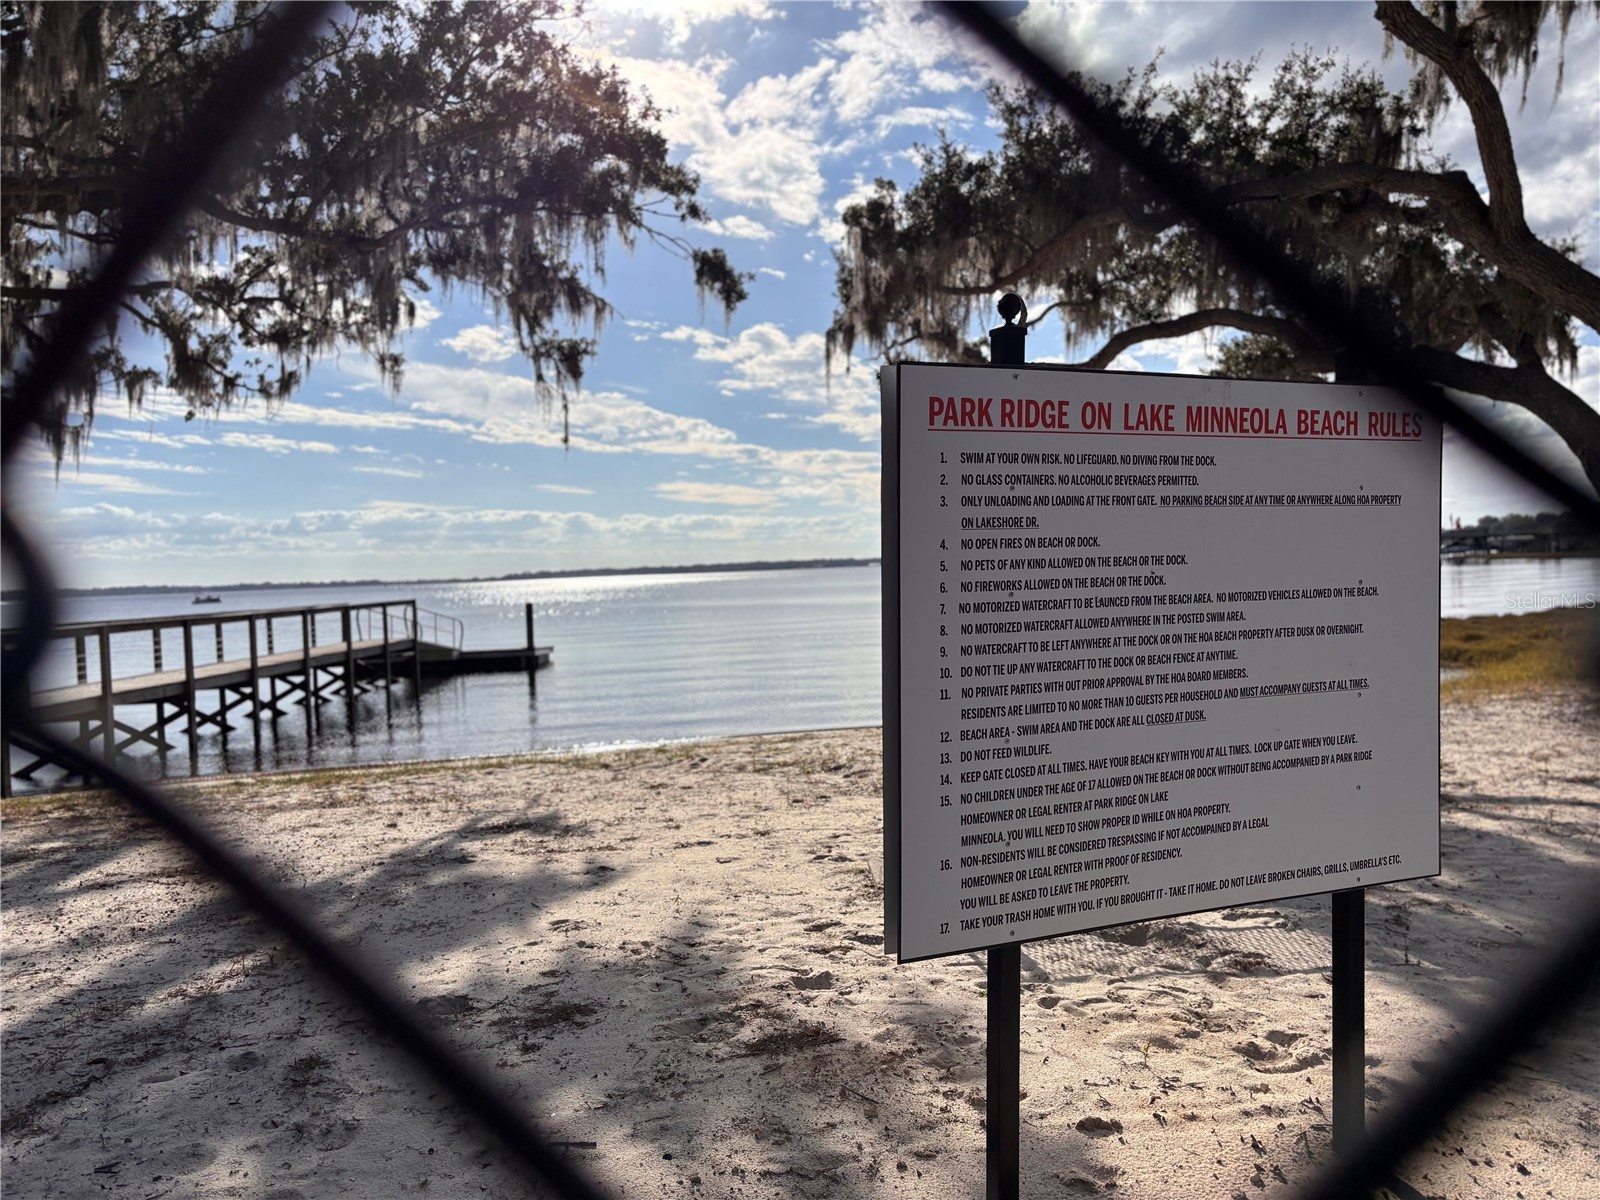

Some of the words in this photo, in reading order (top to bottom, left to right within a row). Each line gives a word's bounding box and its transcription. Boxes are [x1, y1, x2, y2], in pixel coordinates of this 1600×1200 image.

[929, 397, 993, 427] PARK
[1001, 399, 1070, 429] RIDGE
[1081, 402, 1112, 430] ON
[1124, 403, 1175, 431] LAKE
[1186, 406, 1288, 434] MINNEOLA
[1297, 409, 1358, 436] BEACH
[1368, 412, 1422, 437] RULES
[941, 452, 947, 463] 1.
[960, 453, 984, 464] SWIM
[985, 453, 996, 464] AT
[997, 453, 1019, 464] YOUR
[1021, 453, 1040, 464] OWN
[1041, 454, 1062, 464] RISK.
[1064, 454, 1075, 465] NO
[1077, 454, 1119, 465] LIFEGUARD.
[1120, 455, 1131, 465] NO
[1132, 455, 1157, 465] DIVING
[1159, 455, 1179, 466] FROM
[1181, 456, 1194, 466] THE
[1196, 456, 1216, 466] DOCK.
[940, 474, 948, 485] 2.
[961, 474, 974, 485] NO
[975, 474, 1003, 485] GLASS
[1004, 474, 1057, 485] CONTAINERS.
[1058, 475, 1070, 485] NO
[1071, 475, 1113, 485] ALCOHOLIC
[1114, 475, 1156, 485] BEVERAGES
[1158, 475, 1199, 485] PERMITTED.
[940, 496, 948, 507] 3.
[961, 496, 983, 507] ONLY
[984, 495, 1032, 506] UNLOADING
[1033, 495, 1050, 506] AND
[1051, 495, 1085, 506] LOADING
[1086, 495, 1095, 506] AT
[1096, 495, 1110, 506] THE
[1112, 495, 1136, 506] FRONT
[1137, 495, 1157, 506] GATE.
[1160, 495, 1171, 505] NO
[1172, 495, 1203, 505] PARKING
[1204, 495, 1227, 505] BEACH
[1229, 495, 1244, 505] SIDE
[1245, 495, 1253, 505] AT
[1254, 495, 1268, 505] ANY
[1269, 495, 1285, 505] TIME
[1286, 495, 1296, 505] OR
[1297, 495, 1333, 505] ANYWHERE
[1334, 495, 1356, 504] ALONG
[1357, 495, 1370, 504] HOA
[1371, 495, 1402, 504] PROPERTY
[962, 517, 974, 528] ON
[976, 517, 1024, 528] LAKESHORE
[1026, 517, 1039, 527] DR.
[940, 539, 948, 550] 4.
[961, 539, 974, 550] NO
[975, 538, 998, 550] OPEN
[1000, 538, 1022, 549] FIRES
[1024, 538, 1036, 549] ON
[1038, 537, 1063, 548] BEACH
[1065, 537, 1076, 548] OR
[1077, 537, 1100, 547] DOCK.
[940, 561, 948, 572] 5.
[961, 560, 973, 571] NO
[975, 559, 996, 571] PETS
[997, 559, 1009, 570] OF
[1009, 559, 1026, 570] ANY
[1027, 558, 1046, 569] KIND
[1047, 557, 1084, 569] ALLOWED
[1085, 557, 1096, 568] ON
[1097, 557, 1111, 567] THE
[1113, 556, 1138, 567] BEACH
[1139, 556, 1149, 566] OR
[1151, 555, 1164, 566] THE
[1166, 555, 1188, 565] DOCK.
[940, 582, 948, 593] 6.
[961, 581, 973, 593] NO
[974, 580, 1023, 592] FIREWORKS
[1024, 578, 1060, 590] ALLOWED
[1062, 578, 1073, 589] ON
[1074, 577, 1089, 589] THE
[1090, 577, 1115, 588] BEACH
[1116, 576, 1127, 587] OR
[1128, 576, 1142, 587] THE
[1144, 575, 1166, 586] DOCK.
[940, 625, 948, 636] 8.
[961, 624, 973, 635] NO
[975, 621, 1022, 635] MOTORIZED
[1023, 619, 1074, 632] WATERCRAFT
[1074, 617, 1109, 630] ALLOWED
[1110, 615, 1151, 628] ANYWHERE
[1153, 615, 1161, 625] IN
[1162, 614, 1176, 625] THE
[1177, 613, 1205, 624] POSTED
[1206, 612, 1225, 623] SWIM
[1226, 611, 1246, 622] AREA.
[941, 752, 952, 764] 13.
[960, 751, 972, 762] DO
[974, 749, 991, 761] NOT
[992, 747, 1012, 760] FEED
[1013, 743, 1052, 758] WILDLIFE.
[961, 809, 1014, 827] HOMEOWNER
[1015, 807, 1027, 820] OR
[1028, 804, 1052, 818] LEGAL
[1054, 801, 1083, 815] RENTER
[1084, 800, 1093, 811] AT
[1094, 797, 1113, 810] PARK
[1115, 794, 1137, 807] RIDGE
[1138, 793, 1149, 805] ON
[1151, 791, 1168, 803] LAKE
[961, 831, 1006, 847] MINNEOLA.
[1007, 828, 1023, 841] YOU
[1024, 826, 1044, 839] WILL
[1045, 823, 1065, 836] NEED
[1066, 822, 1076, 834] TO
[1078, 819, 1100, 832] SHOW
[1102, 815, 1131, 829] PROPER
[1132, 814, 1140, 825] ID
[1141, 811, 1164, 824] WHILE
[1165, 810, 1176, 821] ON
[1177, 808, 1192, 819] HOA
[1193, 803, 1230, 817] PROPERTY.
[941, 859, 952, 871] 16.
[960, 849, 1026, 868] NON-RESIDENTS
[1027, 846, 1046, 859] WILL
[1047, 845, 1057, 857] BE
[1059, 838, 1106, 855] CONSIDERED
[1107, 832, 1156, 848] TRESPASSING
[1158, 831, 1165, 841] IF
[1166, 828, 1180, 840] NOT
[1233, 820, 1242, 831] BY
[1242, 820, 1247, 830] A
[1249, 817, 1269, 829] LEGAL
[961, 871, 1014, 890] HOMEOWNER
[1016, 869, 1027, 882] OR
[1029, 866, 1052, 880] LEGAL
[1054, 861, 1083, 876] RENTER
[1084, 858, 1104, 871] WITH
[1105, 855, 1129, 868] PROOF
[1131, 853, 1140, 864] OF
[1141, 847, 1182, 863] RESIDENCY.
[960, 897, 977, 911] YOU
[978, 894, 998, 908] WILL
[999, 892, 1010, 905] BE
[1011, 888, 1037, 903] ASKED
[1038, 886, 1048, 899] TO
[1050, 883, 1073, 897] LEAVE
[1074, 880, 1089, 893] THE
[1090, 874, 1129, 891] PROPERTY.
